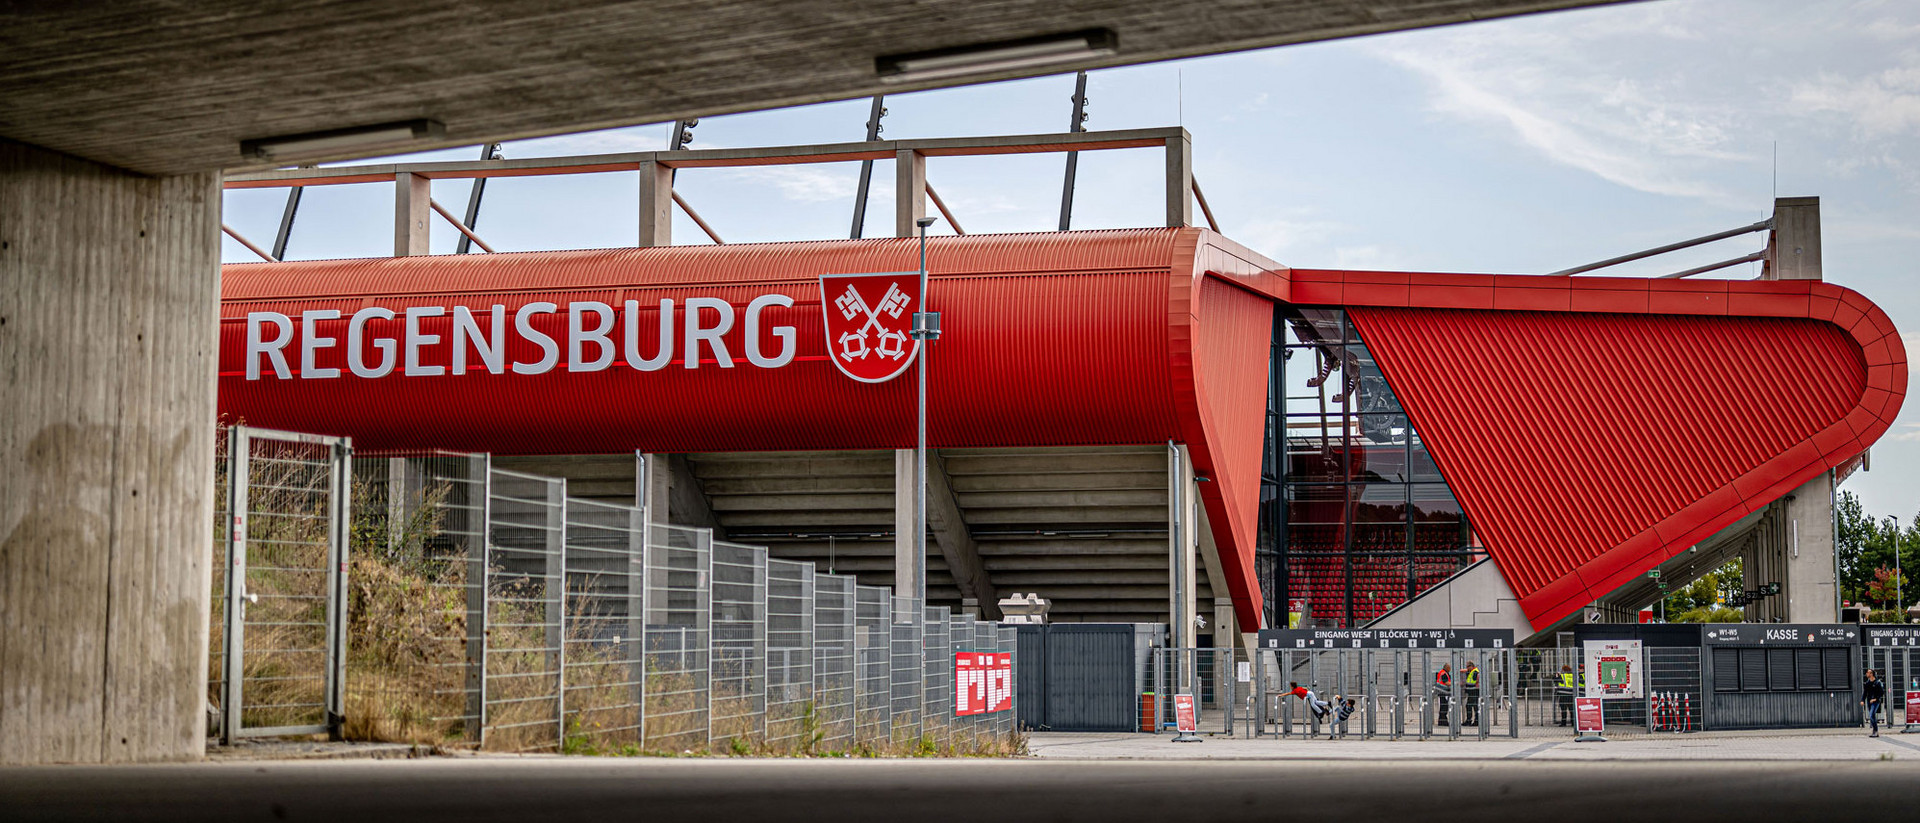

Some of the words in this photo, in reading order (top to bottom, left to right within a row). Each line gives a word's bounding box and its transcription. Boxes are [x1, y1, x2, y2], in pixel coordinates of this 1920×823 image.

[245, 294, 797, 381] REGENSBURG
[1315, 631, 1349, 639] EINGANG
[1380, 629, 1409, 638] BLÖCKE
[1766, 629, 1798, 640] KASSE
[1894, 628, 1905, 637] SÜD
